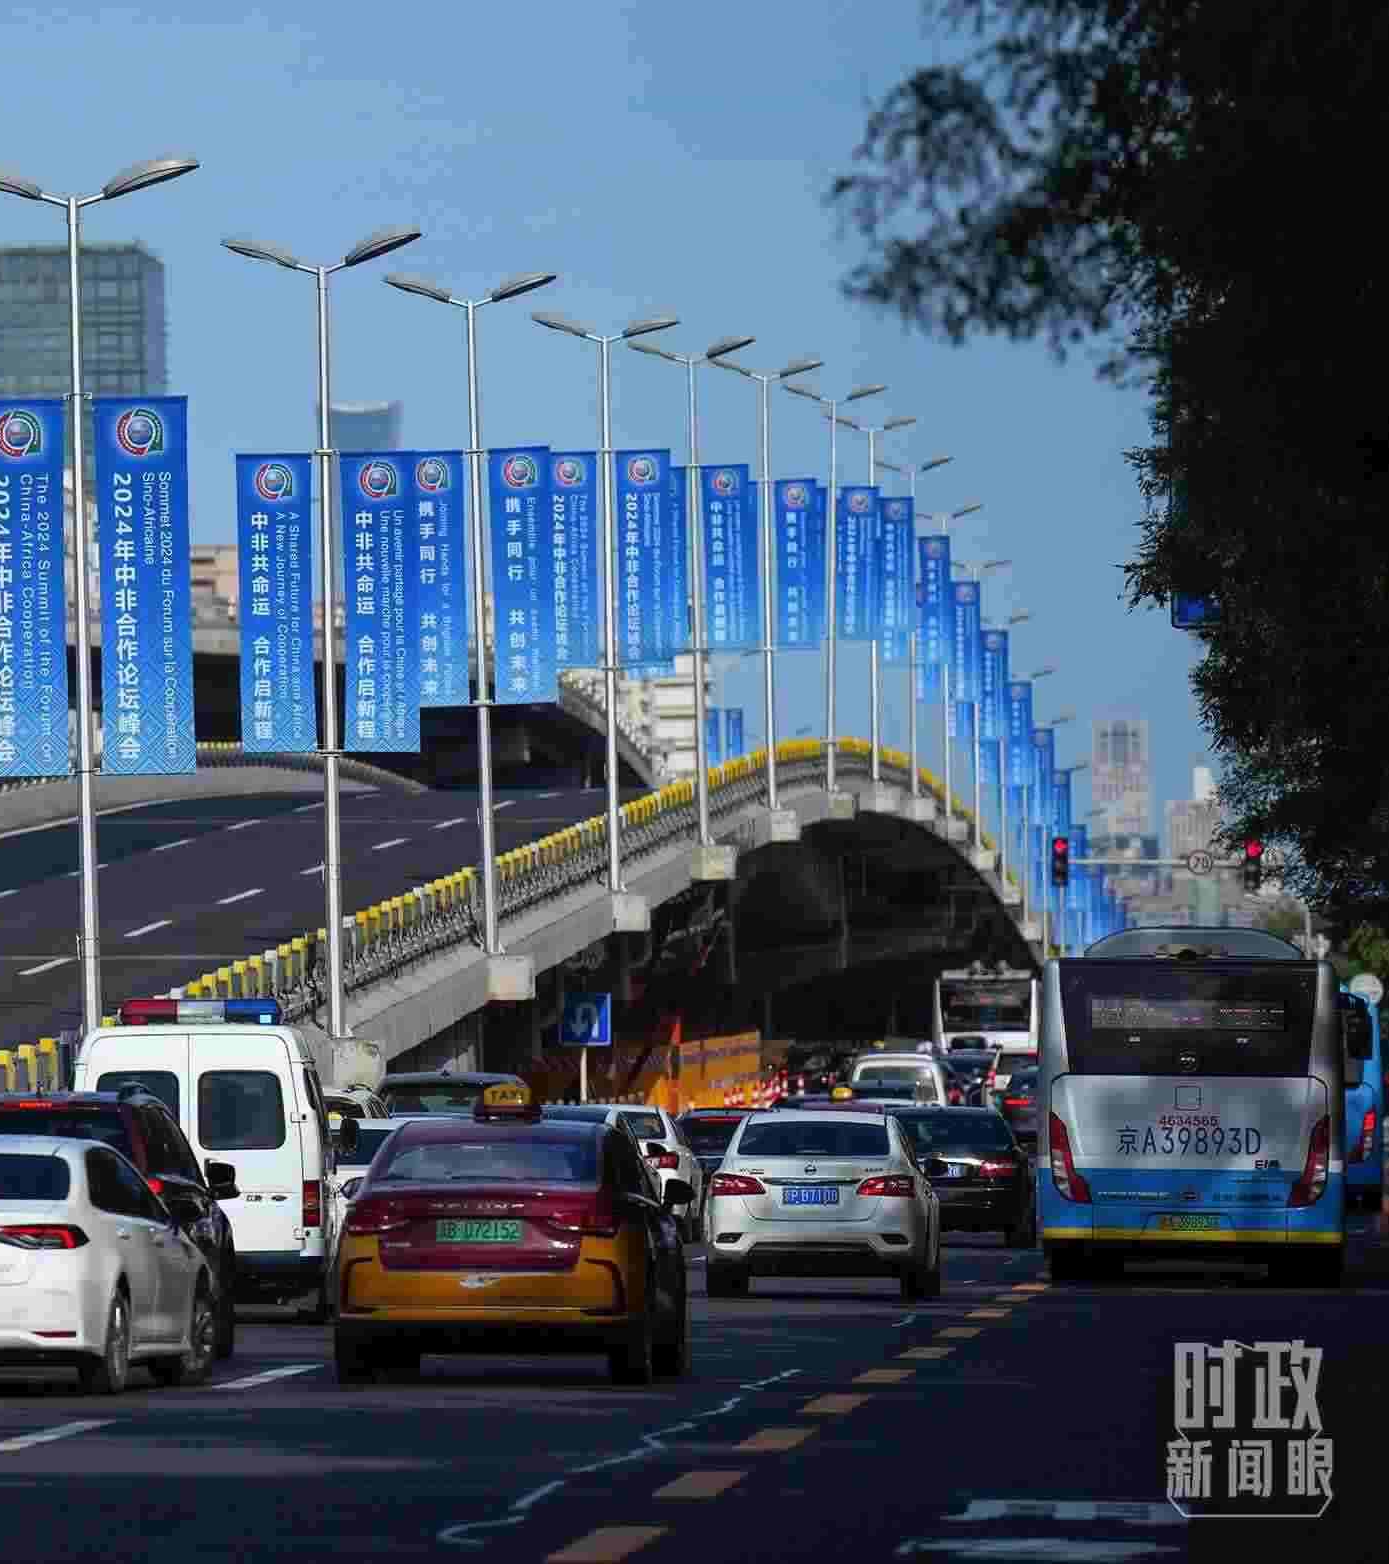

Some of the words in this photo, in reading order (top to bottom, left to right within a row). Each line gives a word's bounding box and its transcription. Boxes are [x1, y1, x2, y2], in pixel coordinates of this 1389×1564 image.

[112, 472, 141, 761] 2024年中非合作论坛峰会
[1116, 1125, 1261, 1155] 京A39893D
